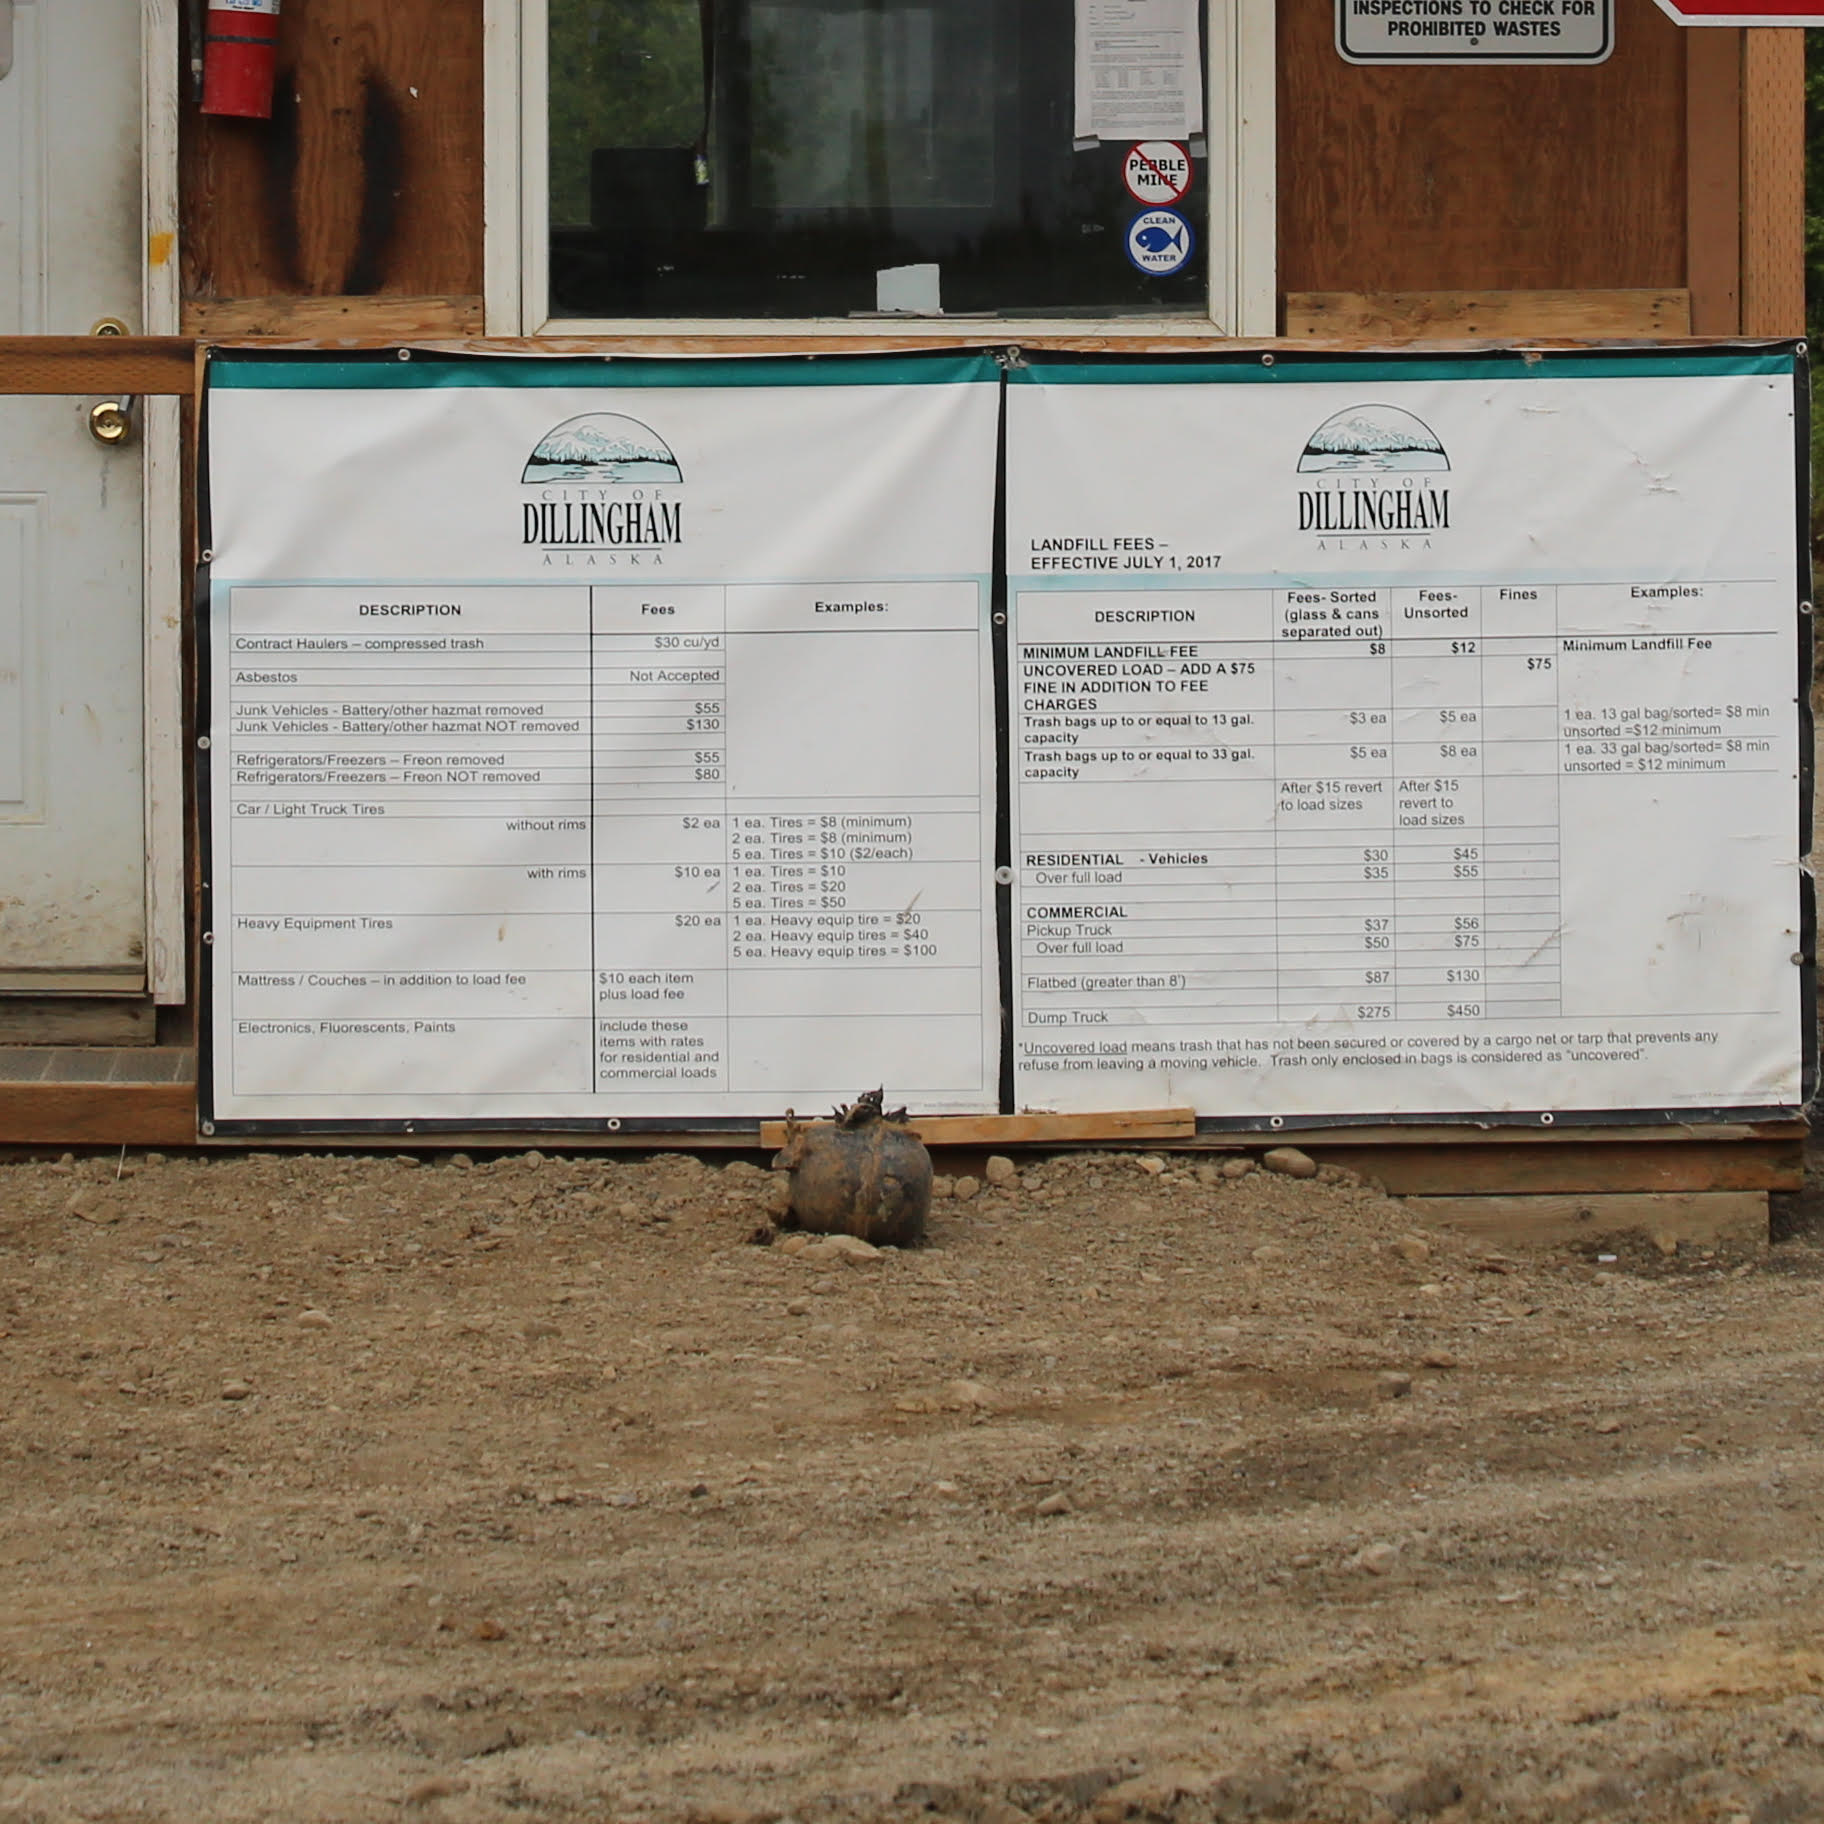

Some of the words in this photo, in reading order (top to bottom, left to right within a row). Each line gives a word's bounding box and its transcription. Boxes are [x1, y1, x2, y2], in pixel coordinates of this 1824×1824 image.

[1353, 0, 1462, 15] INSPECTIONS
[1470, 1, 1491, 15] TO
[1499, 1, 1554, 16] CHECK
[1562, 1, 1595, 15] FOR
[1388, 22, 1486, 36] PROHIBITED
[1494, 22, 1560, 36] WASTES
[1130, 160, 1186, 171] PEBBLE
[1138, 175, 1178, 186] MINE
[1317, 478, 1379, 488] CITY
[1403, 477, 1431, 487] OF
[542, 490, 607, 501] CITY
[632, 490, 663, 500] OF
[1298, 489, 1449, 530] DILLINGHAM
[522, 502, 683, 544] DILLINGHAM
[1031, 538, 1108, 552] LANDFILL
[1114, 538, 1155, 551] FEES
[1317, 539, 1432, 550] ALASKA
[542, 554, 663, 565] ALASKA
[1031, 557, 1118, 570] EFFECTIVE
[1124, 557, 1164, 569] JULY
[1170, 557, 1182, 570] 1,
[1187, 555, 1221, 568] 2017
[1287, 592, 1327, 604] Fees-
[1330, 591, 1376, 603] Sorted
[1419, 590, 1458, 602] Fees-
[1499, 588, 1537, 600] Fines
[1631, 586, 1704, 599] Examples:
[359, 604, 462, 616] DESCRIPTION
[641, 604, 675, 616] Fees
[814, 601, 888, 614] Examples:
[1404, 606, 1468, 619] Unsorted
[1095, 610, 1195, 623] DESCRIPTION
[1281, 627, 1351, 640] separated
[1355, 625, 1384, 639] out)
[655, 636, 679, 649] $30
[684, 636, 720, 651] cu/yd
[1370, 643, 1386, 656] $8
[1451, 641, 1476, 654] $12
[1562, 639, 1627, 652] Minimum
[1631, 638, 1684, 650] Landfill
[1687, 638, 1712, 650] Fee
[1024, 646, 1090, 659] MINIMUM
[1094, 646, 1165, 658] LANDFILL
[1170, 645, 1198, 657] FEE
[1527, 657, 1552, 671] $75
[236, 671, 298, 684] Asbestos
[630, 670, 653, 682] Not
[660, 669, 720, 684] Accepted
[1024, 681, 1057, 694] FINE
[1062, 681, 1075, 693] IN
[1080, 680, 1152, 693] ADDITION
[1157, 680, 1176, 692] TO
[1180, 679, 1208, 692] FEE
[694, 702, 720, 715] $55
[1024, 698, 1097, 711] CHARGES
[686, 718, 720, 731] $130
[1024, 731, 1079, 745] capacity
[694, 768, 720, 781] $80
[506, 818, 554, 831] without
[558, 818, 587, 830] rims
[683, 817, 700, 830] $2
[704, 819, 720, 829] ea
[1026, 853, 1124, 867] RESIDENTIAL
[1364, 848, 1389, 863] $30
[1453, 847, 1478, 861] $45
[527, 867, 554, 879] with
[558, 867, 587, 878] rims
[1026, 906, 1128, 919] COMMERCIAL
[237, 918, 280, 931] Heavy
[284, 918, 356, 931] Equipment
[361, 917, 393, 929] Tires
[675, 914, 700, 927] $20
[704, 916, 721, 926] ea
[1026, 924, 1069, 939] Pickup
[1074, 923, 1112, 936] Truck
[599, 972, 625, 985] $10
[629, 972, 661, 984] each
[665, 972, 694, 984] item
[599, 989, 627, 1002] plus
[631, 988, 660, 1000] load
[663, 988, 685, 1000] fee
[1357, 1005, 1391, 1020] $275
[1447, 1003, 1480, 1018] $450
[1027, 1011, 1067, 1026] Dump
[1072, 1010, 1108, 1024] Truck
[238, 1022, 316, 1035] Electronics,
[320, 1022, 410, 1034] Fluorescents,
[414, 1021, 456, 1034] Paints
[599, 1020, 648, 1033] include
[652, 1020, 688, 1032] these
[599, 1036, 636, 1048] items
[640, 1036, 667, 1048] with
[671, 1036, 704, 1047] rates
[599, 1067, 677, 1079] commercial
[681, 1067, 717, 1079] loads
